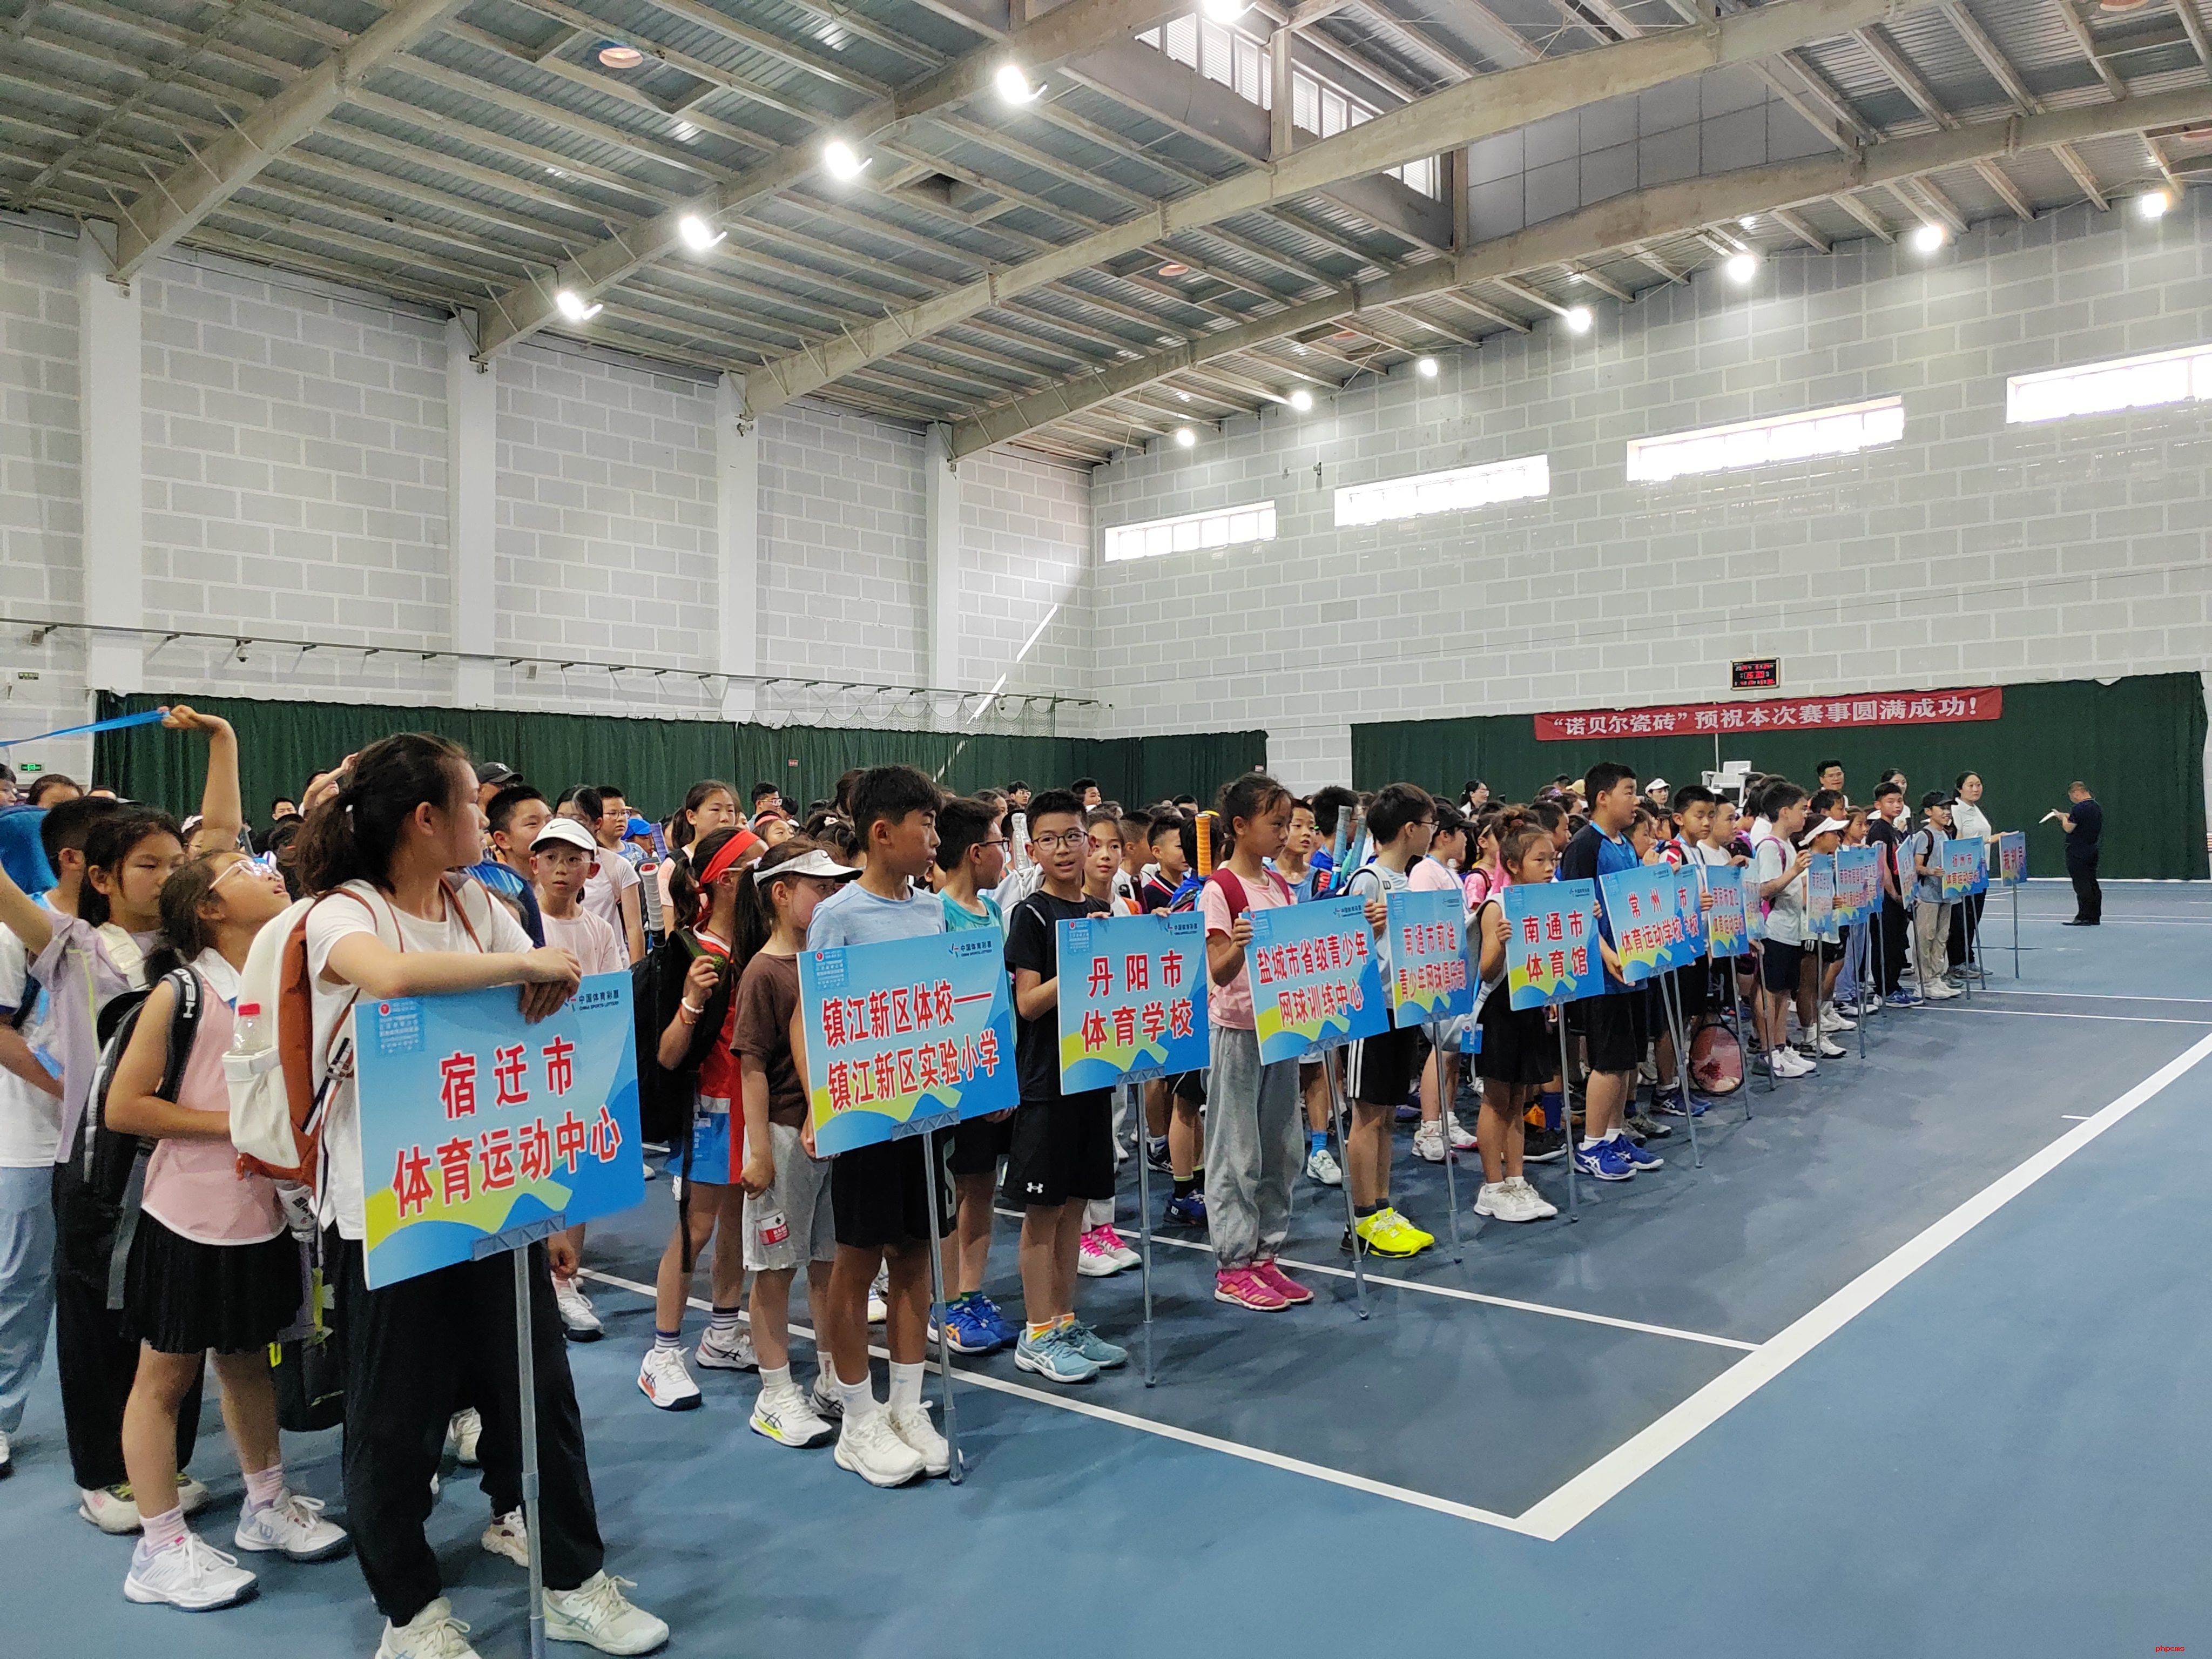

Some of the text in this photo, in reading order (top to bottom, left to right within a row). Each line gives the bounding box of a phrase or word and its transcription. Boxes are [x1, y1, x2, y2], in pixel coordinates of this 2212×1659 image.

[1522, 909, 1583, 944] 南通市
[1088, 950, 1184, 999] 丹阳市
[1256, 931, 1368, 985] 盐城市省级青少年
[1526, 945, 1588, 983] 体育馆
[172, 968, 196, 1018] HEAD
[1278, 980, 1364, 1028] 网球训练中心
[1081, 998, 1193, 1054] 体育学校
[440, 1035, 575, 1120] 宿迁市
[827, 1029, 1000, 1112] 镇江新区实验小学
[392, 1105, 622, 1219] 体育运动中心
